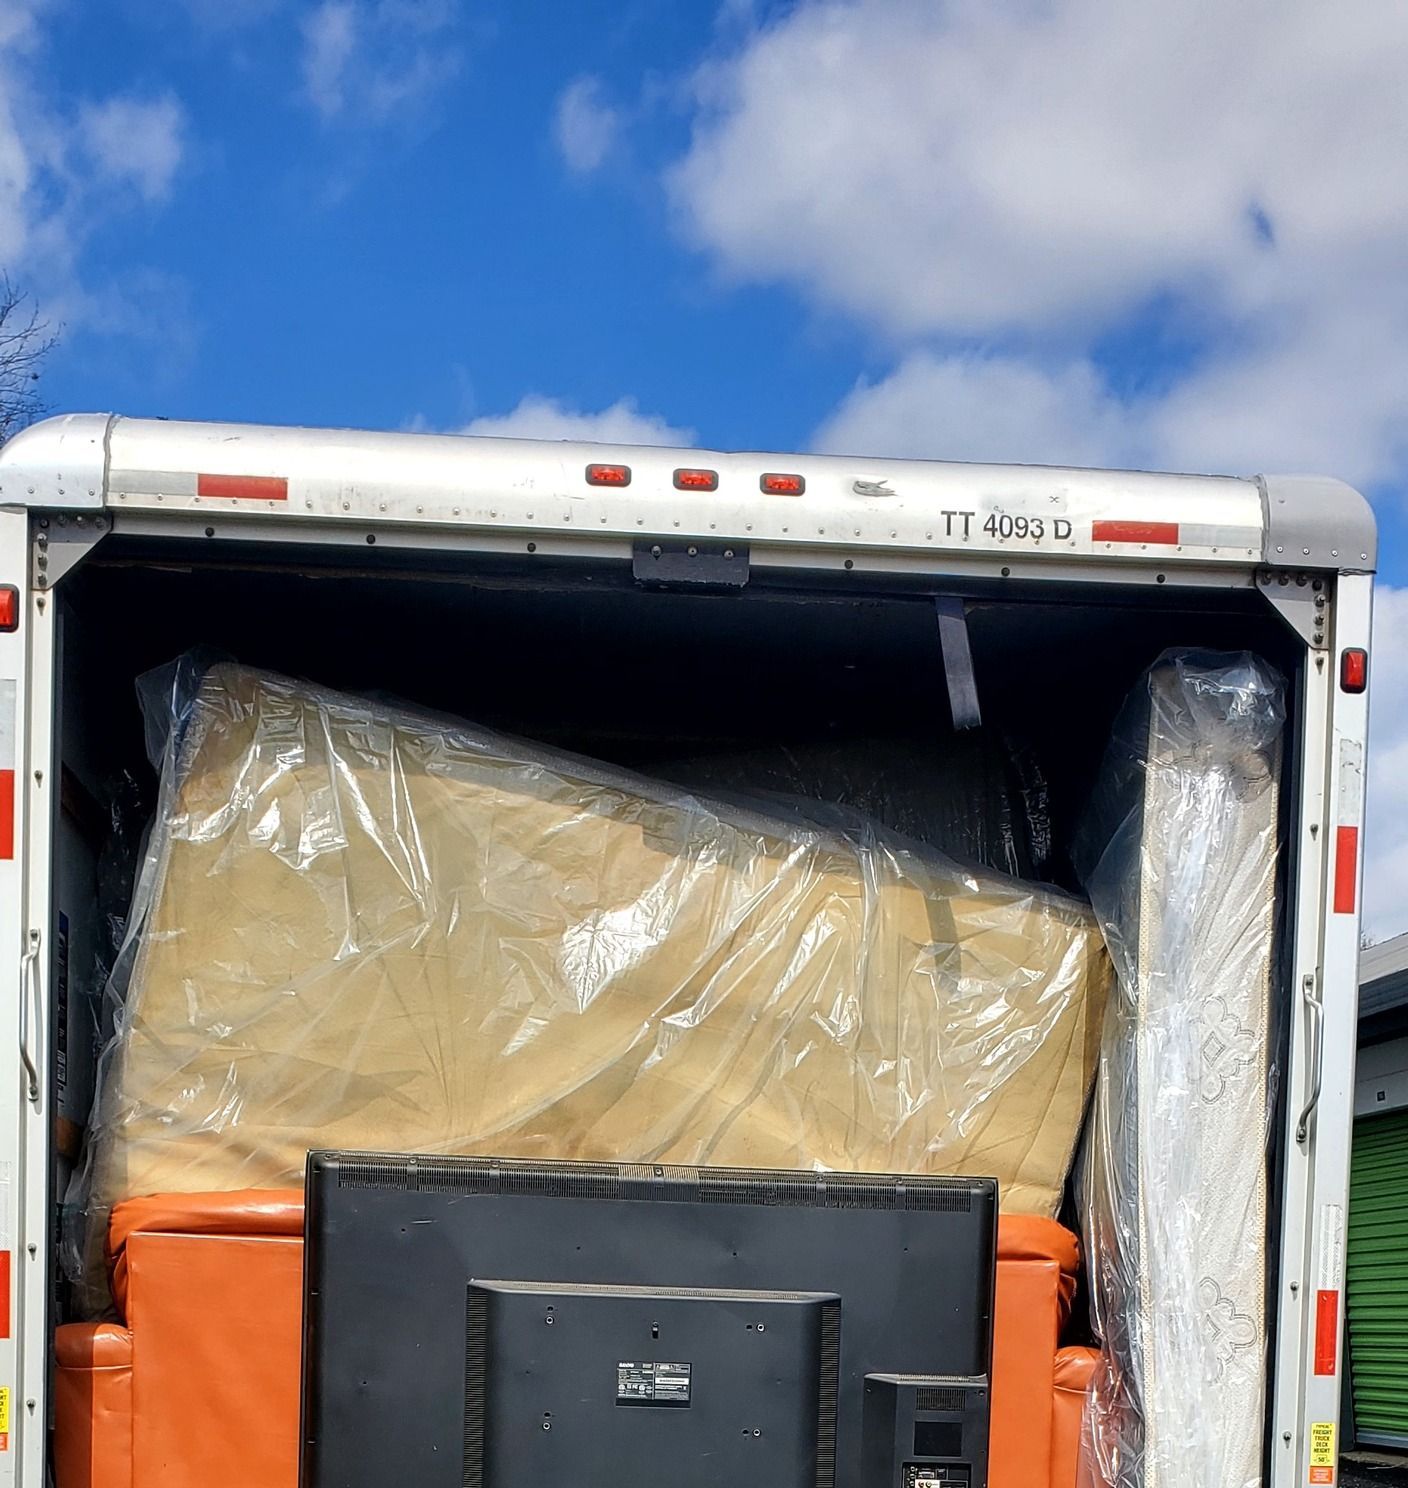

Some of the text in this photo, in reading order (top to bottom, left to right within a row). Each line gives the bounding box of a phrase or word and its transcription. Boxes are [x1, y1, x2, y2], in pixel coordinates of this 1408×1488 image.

[940, 510, 1073, 541] TT 4093 D
